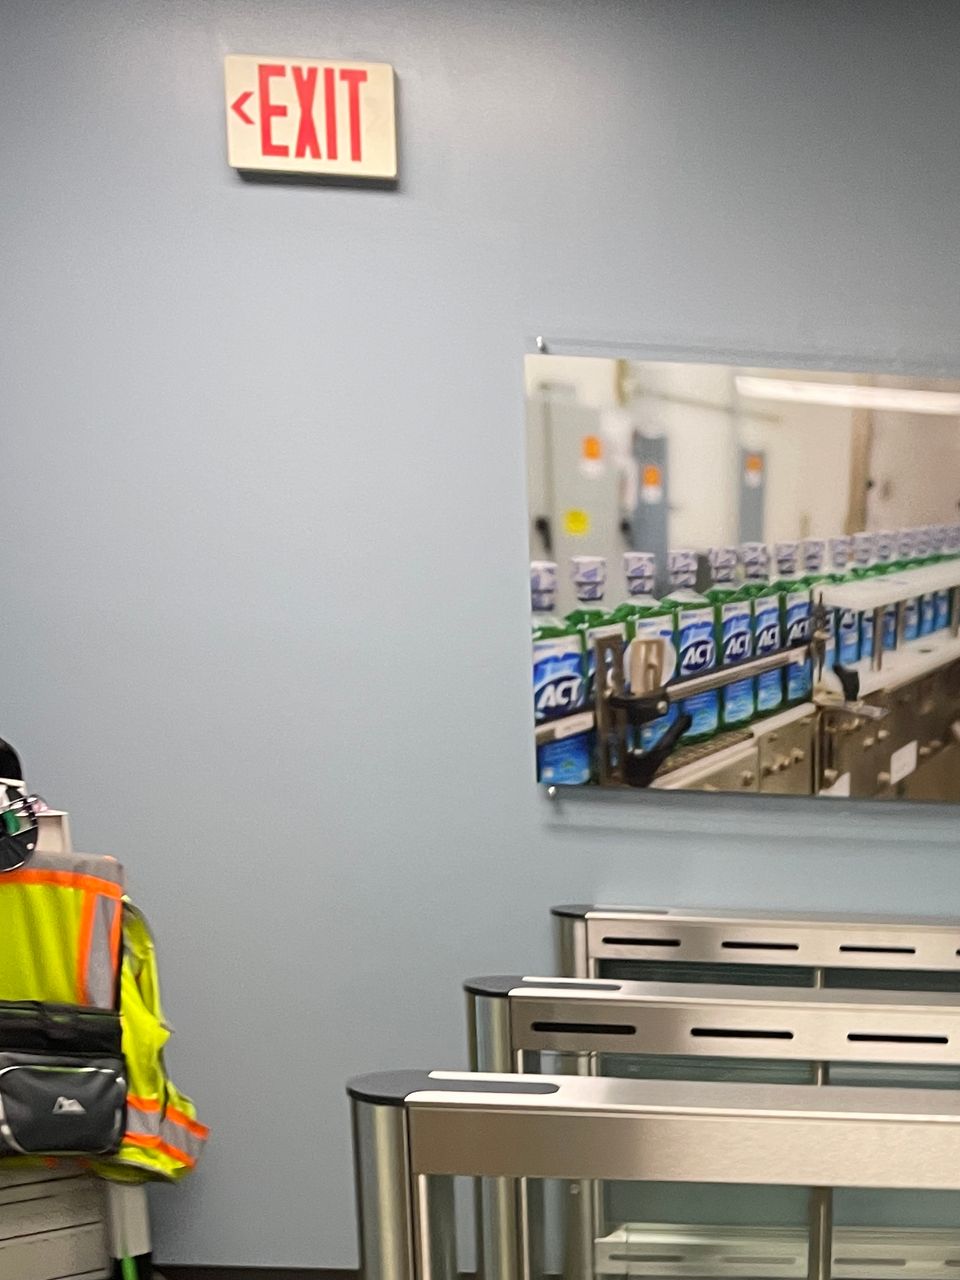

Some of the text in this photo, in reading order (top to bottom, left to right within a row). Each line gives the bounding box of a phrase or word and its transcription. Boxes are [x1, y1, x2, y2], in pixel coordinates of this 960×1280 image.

[258, 64, 368, 162] EXIT
[725, 634, 749, 656] ACT
[757, 625, 779, 649] ACT
[682, 643, 713, 667] ACT
[537, 678, 581, 710] ACT
